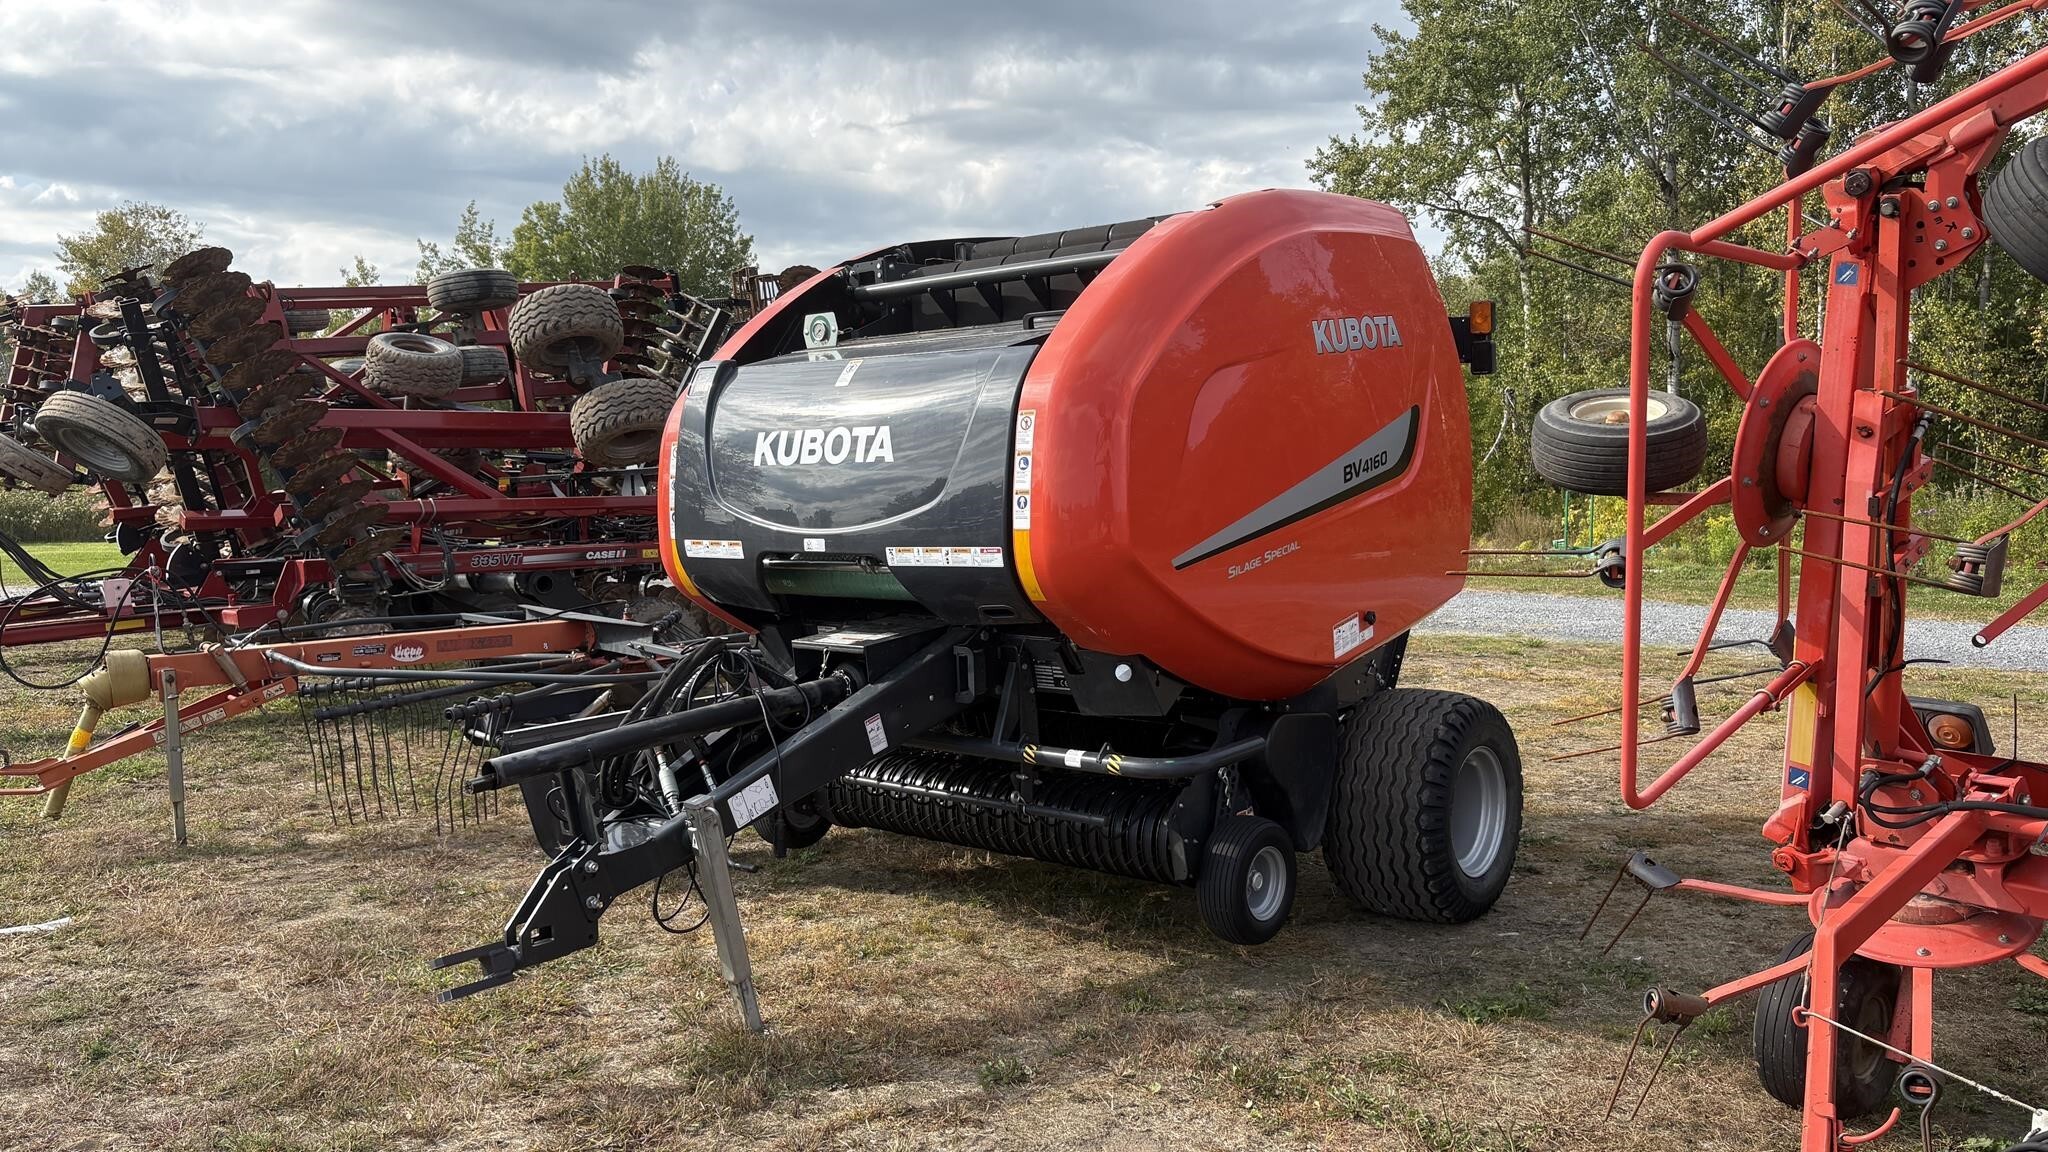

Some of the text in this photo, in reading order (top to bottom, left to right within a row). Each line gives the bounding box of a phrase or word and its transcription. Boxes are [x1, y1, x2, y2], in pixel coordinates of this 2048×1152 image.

[1312, 315, 1403, 355] KUBOTA
[753, 425, 894, 467] KUBOTA
[1343, 450, 1388, 484] BV4160
[471, 552, 523, 568] 335 VT
[586, 550, 615, 560] CASE
